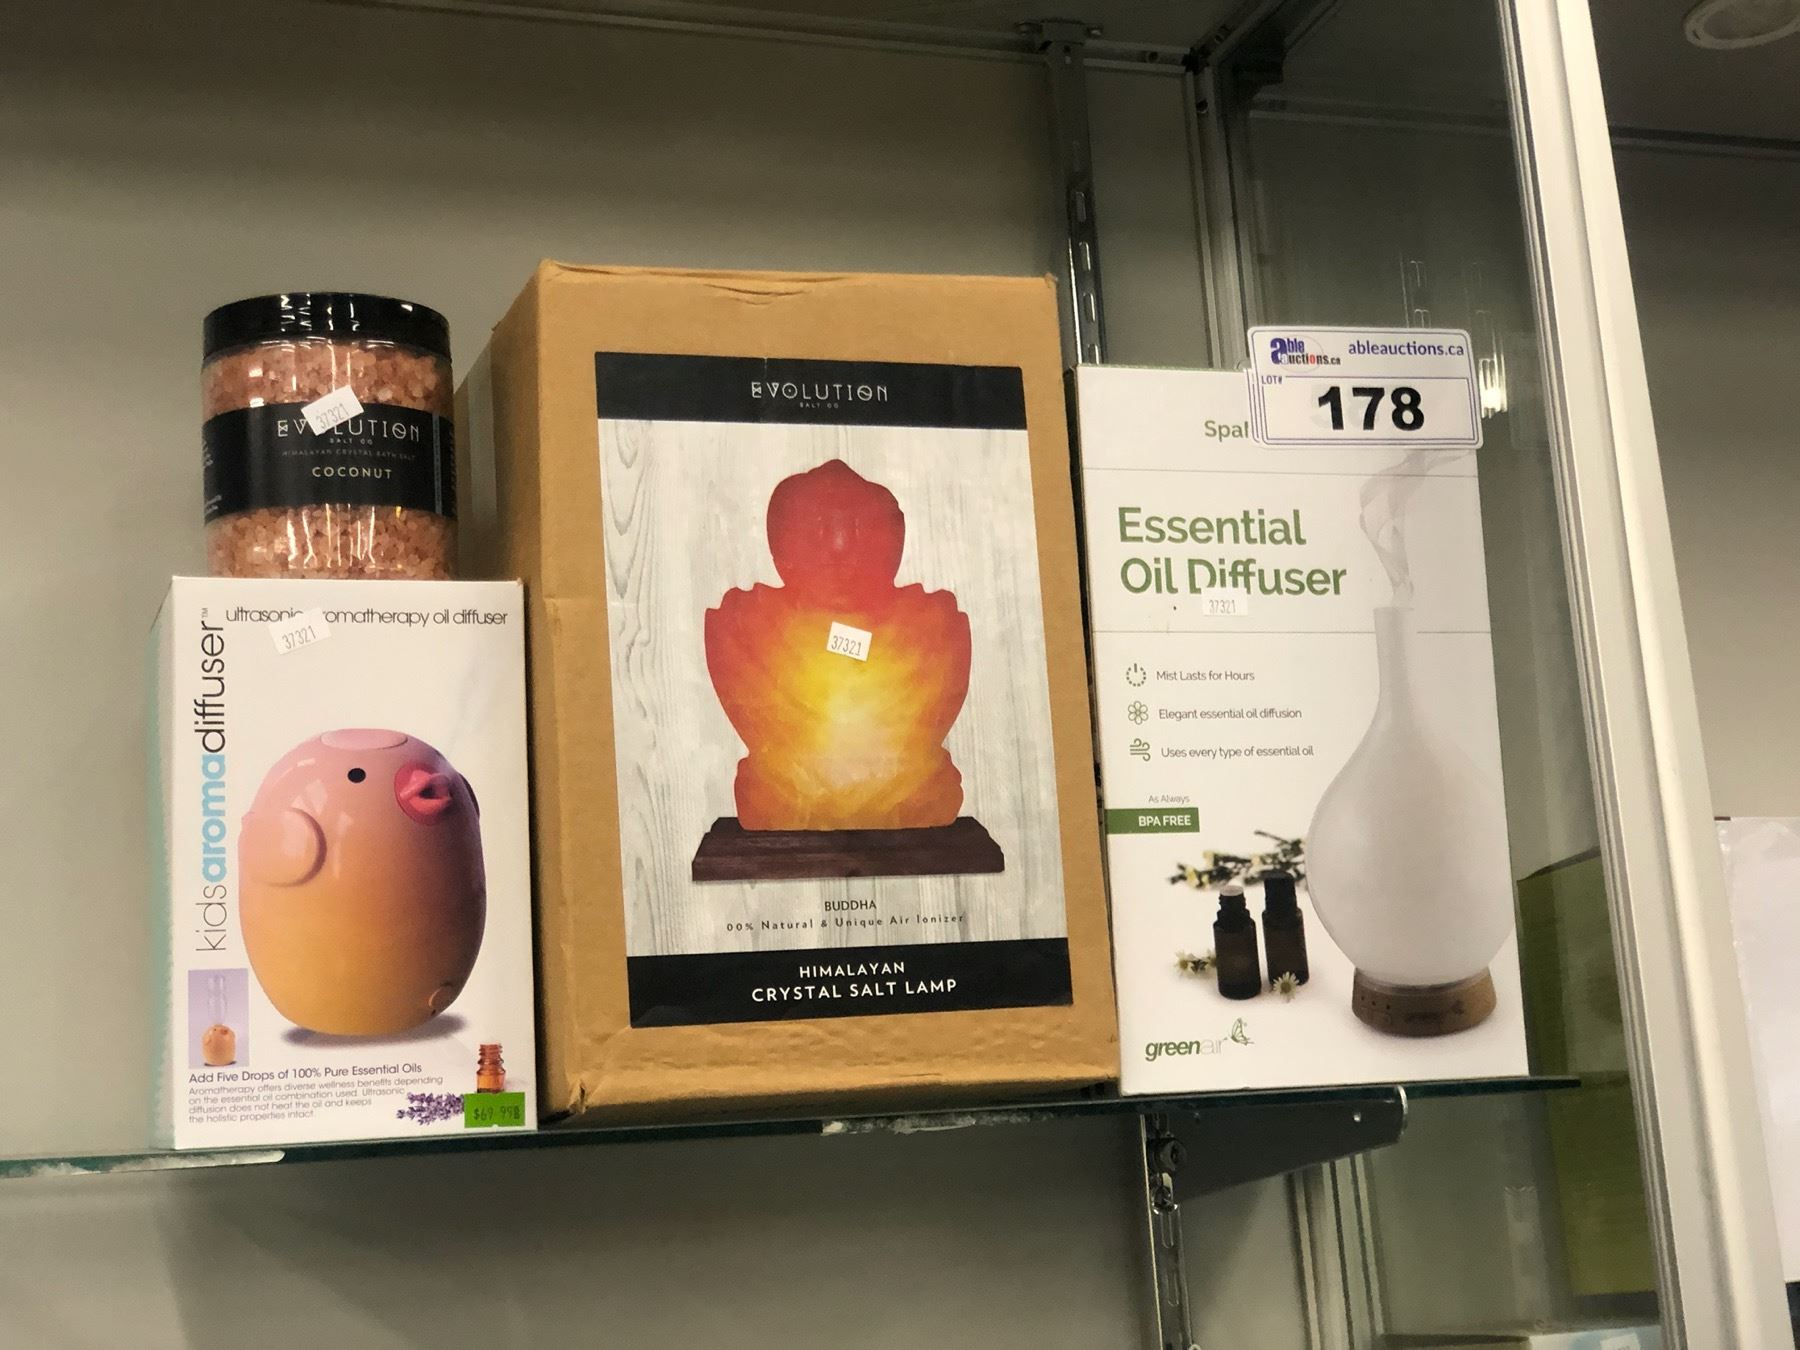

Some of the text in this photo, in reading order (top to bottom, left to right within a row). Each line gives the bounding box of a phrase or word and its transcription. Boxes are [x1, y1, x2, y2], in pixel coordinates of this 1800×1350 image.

[1348, 341, 1464, 361] ableauctions.ca
[751, 382, 888, 402] EVOLUTION
[1318, 386, 1424, 431] 178
[277, 419, 419, 442] EVLUTION
[311, 466, 393, 479] COCONUT
[1118, 506, 1308, 546] Essential
[1120, 556, 1348, 596] Oil Diffuser
[1208, 599, 1236, 615] 37321
[432, 608, 450, 625] oil
[452, 608, 509, 626] diffuser
[282, 624, 318, 651] 37321
[831, 635, 862, 657] 37321
[1156, 669, 1255, 681] Mist Lasts for Hours
[1158, 707, 1302, 721] Elegant essential oil diffusion
[1161, 744, 1314, 761] Uses every type of essential oil
[1161, 795, 1190, 805] Always
[1138, 815, 1192, 827] BPA FREE
[824, 900, 878, 912] BUDDHA
[761, 918, 814, 931] Natural
[821, 919, 828, 928] &
[835, 916, 884, 931] Unique
[890, 914, 911, 926] Air
[799, 961, 906, 979] HIMALAYAN
[751, 978, 958, 1003] CRYSTAL SALT LAMP
[188, 1062, 423, 1084] Add Five Drops of 100% Pure Essential Oils
